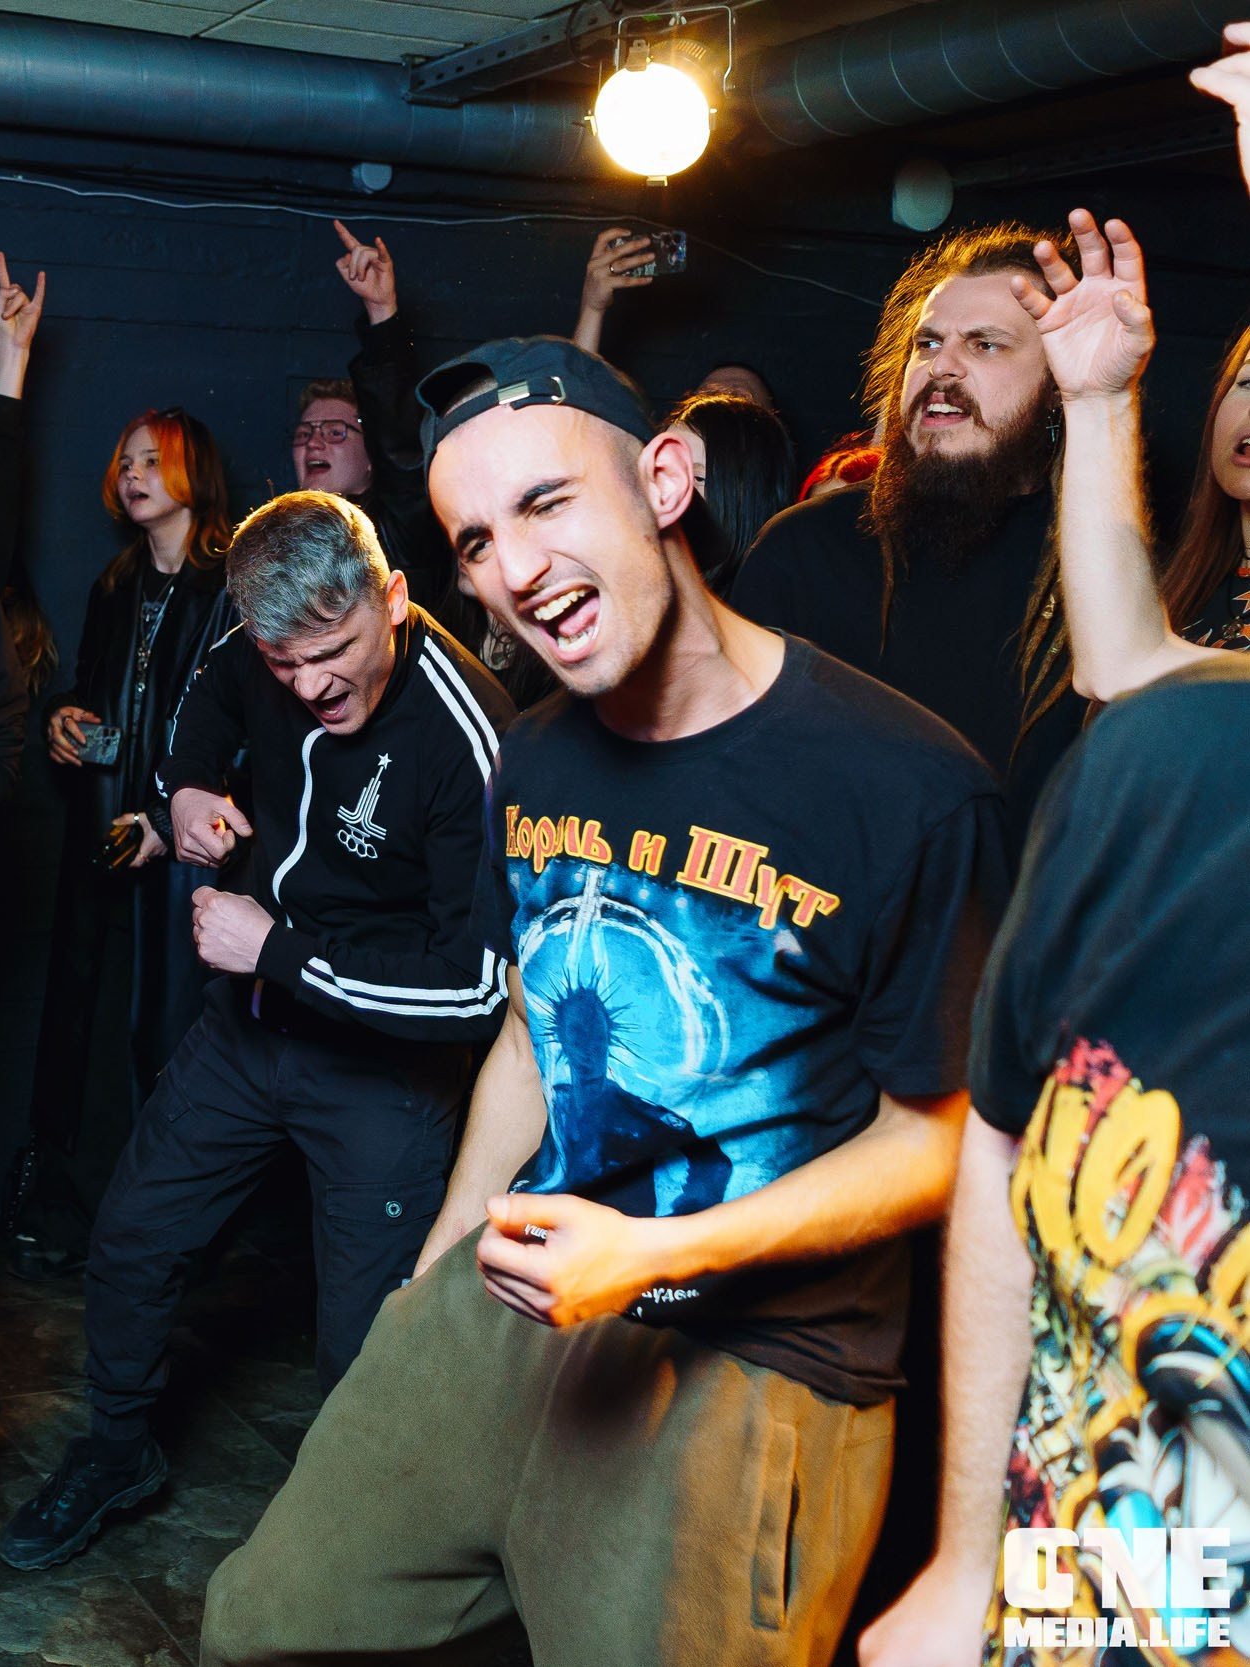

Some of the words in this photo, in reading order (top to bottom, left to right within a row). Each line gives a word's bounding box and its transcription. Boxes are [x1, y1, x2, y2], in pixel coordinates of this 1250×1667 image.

[506, 805, 612, 873] Корль
[628, 830, 667, 876] и
[676, 825, 841, 930] Шут
